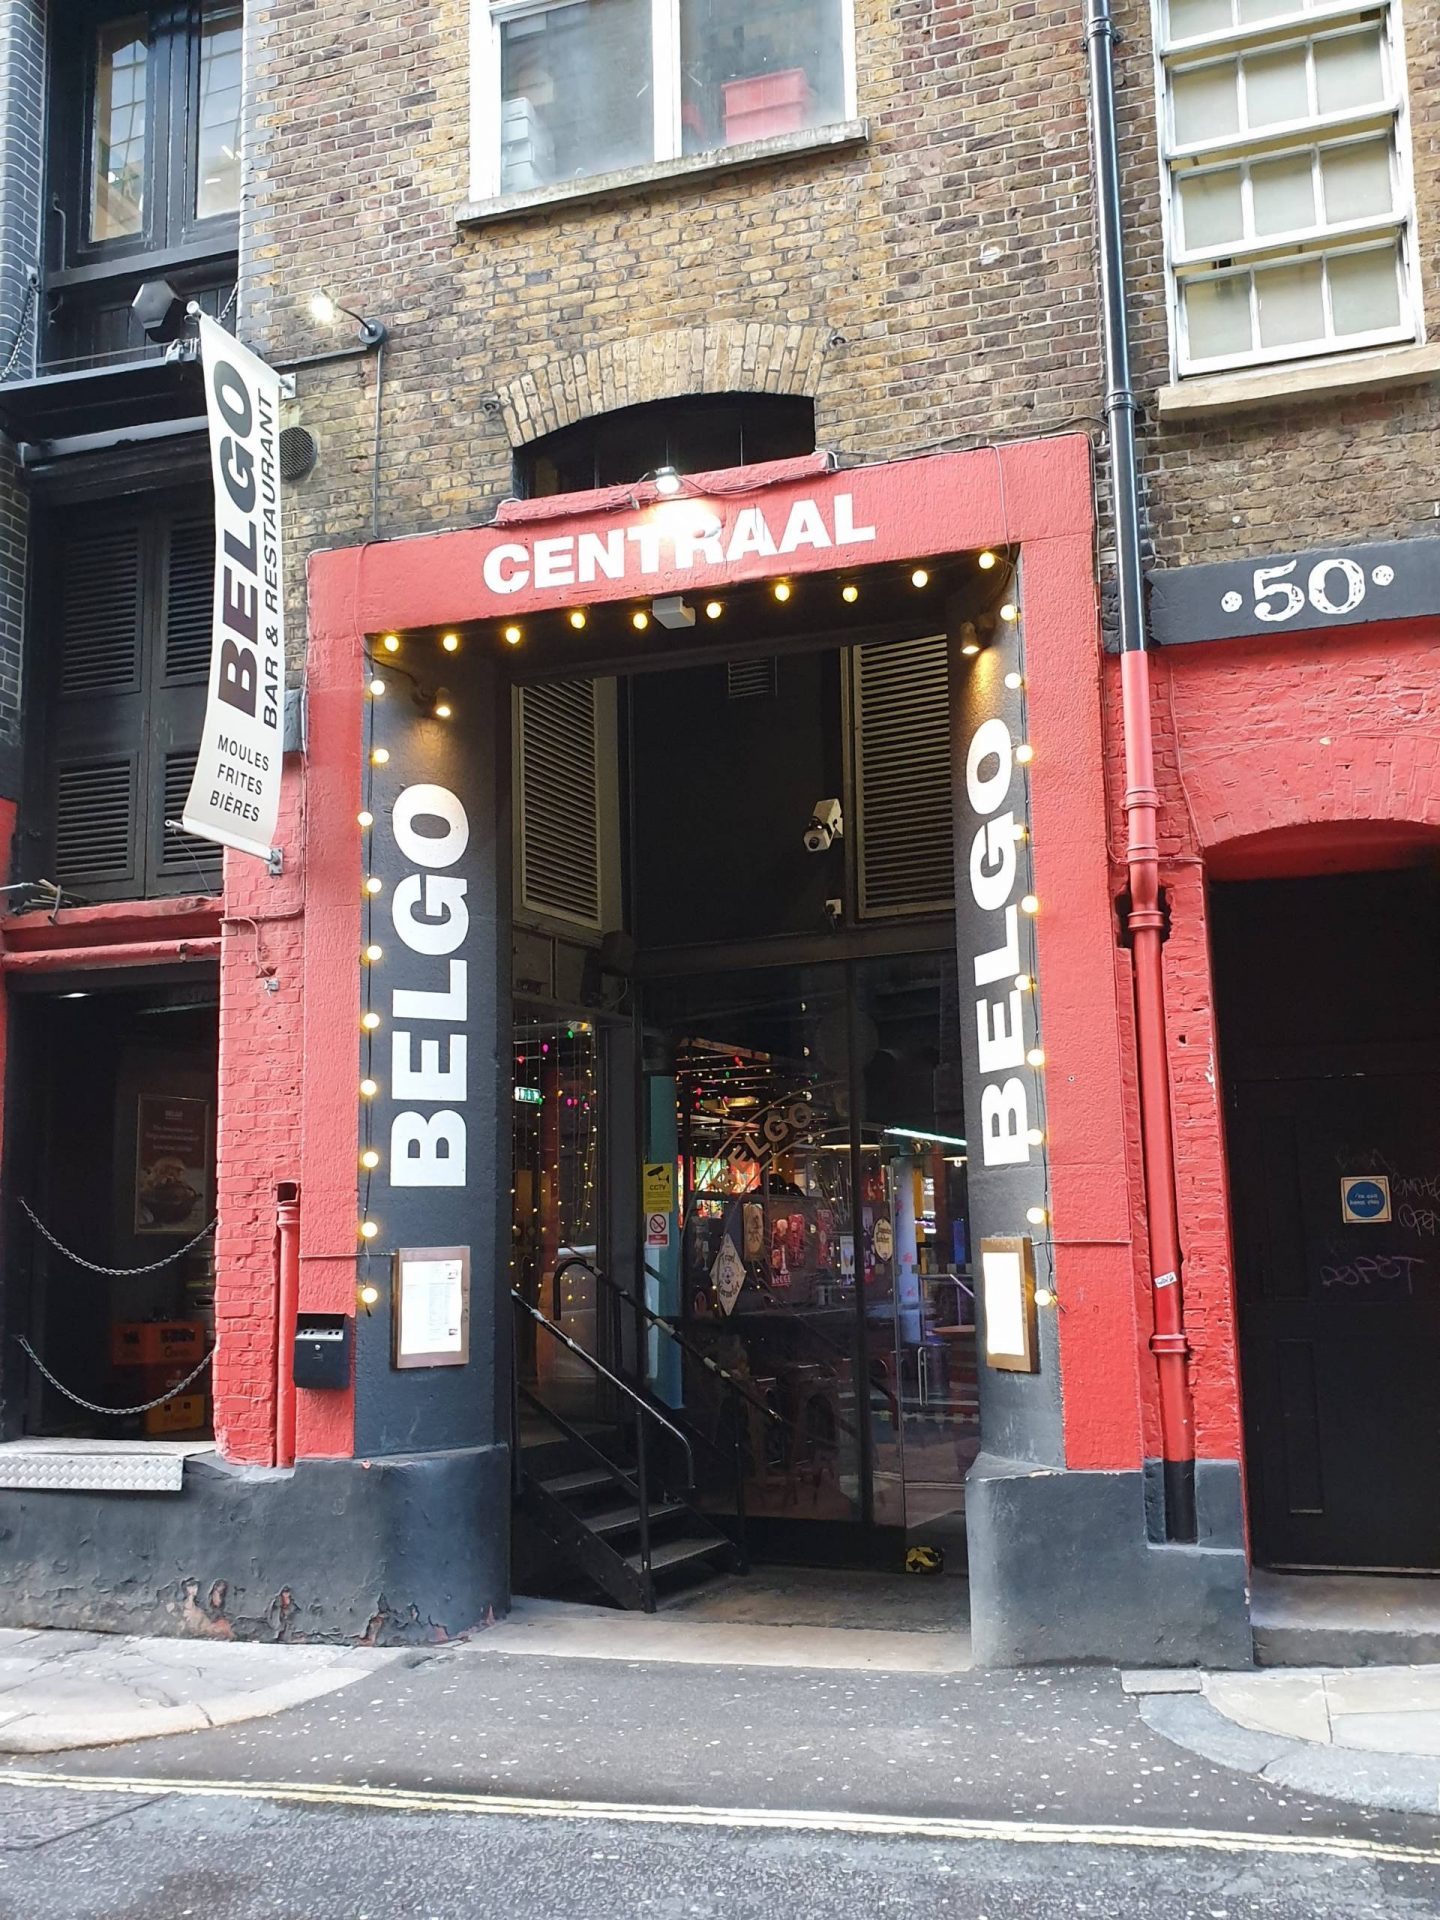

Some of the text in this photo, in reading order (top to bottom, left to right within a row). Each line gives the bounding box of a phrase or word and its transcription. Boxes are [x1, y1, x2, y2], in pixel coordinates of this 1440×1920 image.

[214, 360, 258, 718] BELGO
[258, 387, 279, 730] BAR & RESTAURANT
[482, 493, 876, 595] CENTRAAL
[217, 763, 263, 796] FRITES
[218, 734, 270, 772] MOULES
[209, 791, 260, 823] BIÈRES
[390, 783, 470, 1187] BELGO
[966, 718, 1030, 1166] BELGO
[708, 1102, 812, 1196] BELGO
